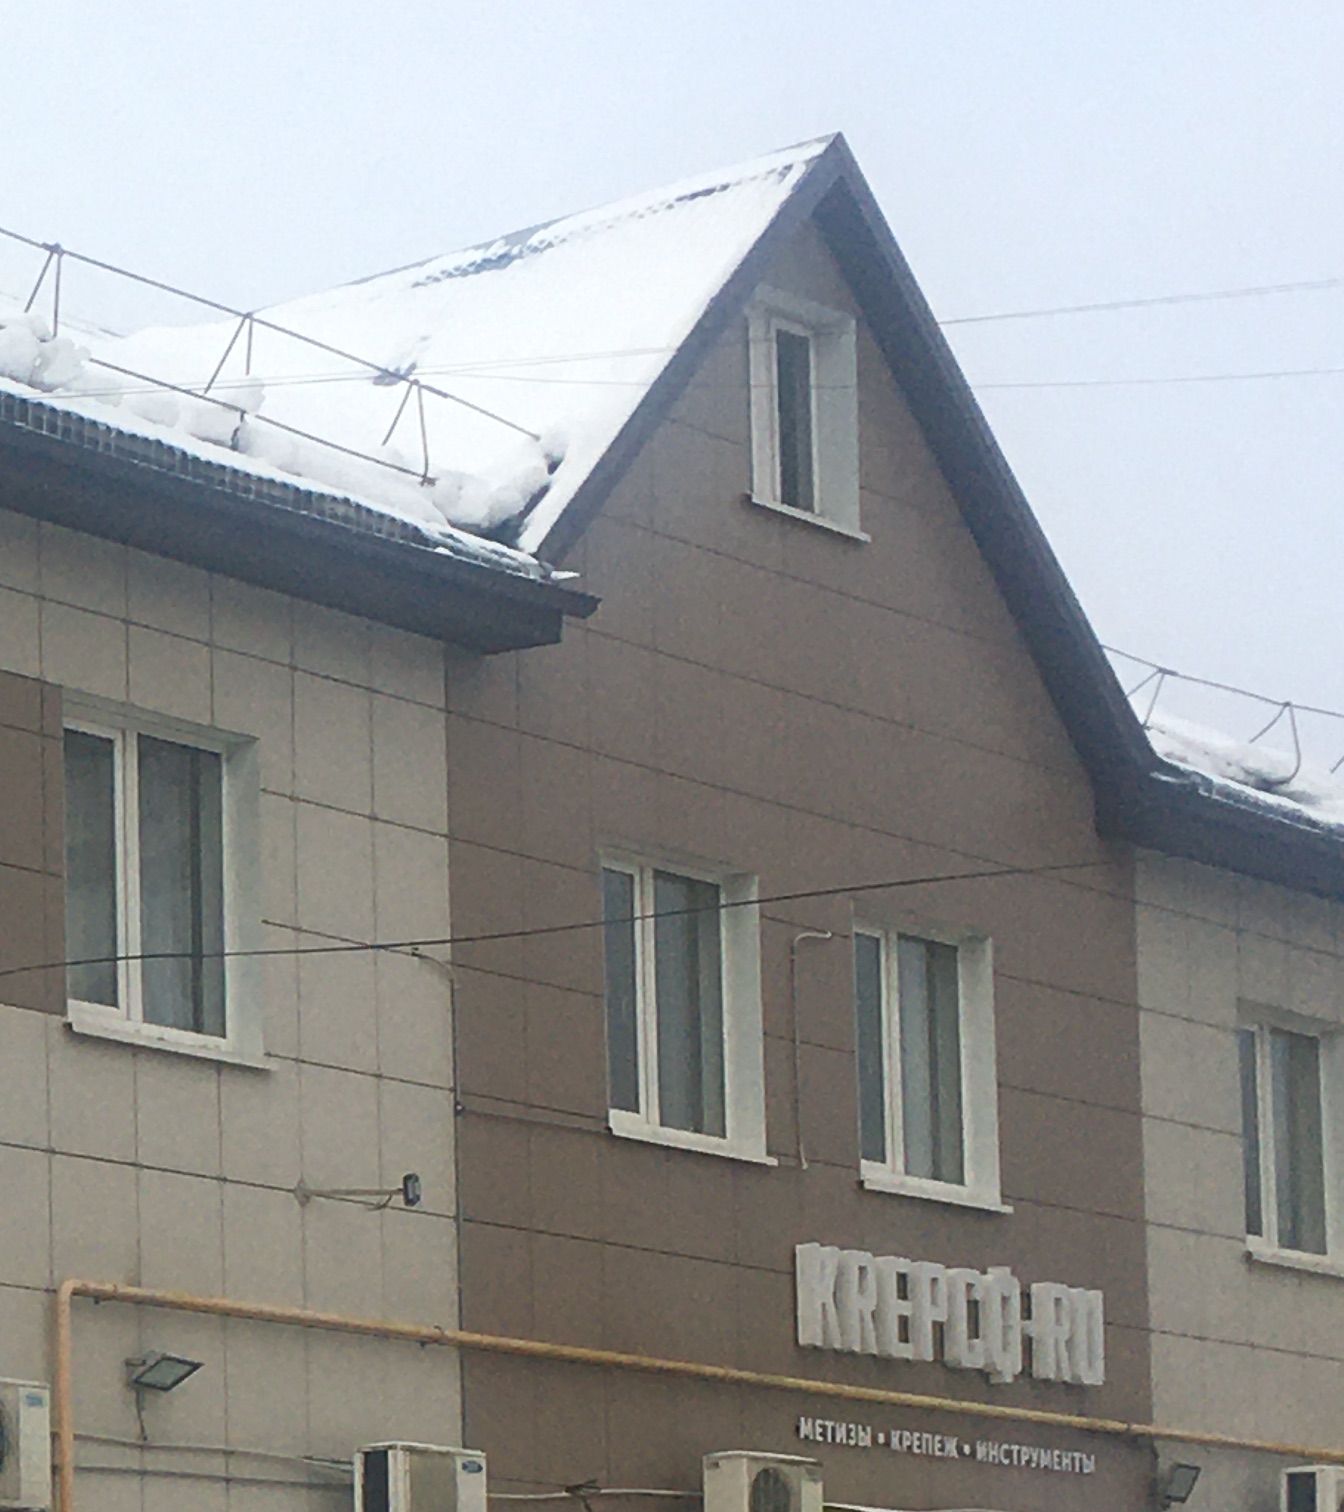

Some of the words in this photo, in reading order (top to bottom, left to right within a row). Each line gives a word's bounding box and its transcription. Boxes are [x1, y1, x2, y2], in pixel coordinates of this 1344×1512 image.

[797, 1416, 872, 1448] МЕТИЗЫ
[889, 1429, 959, 1459] КРЕПЕЖ
[975, 1440, 1096, 1474] ИНСТРУМЕНТЫ
